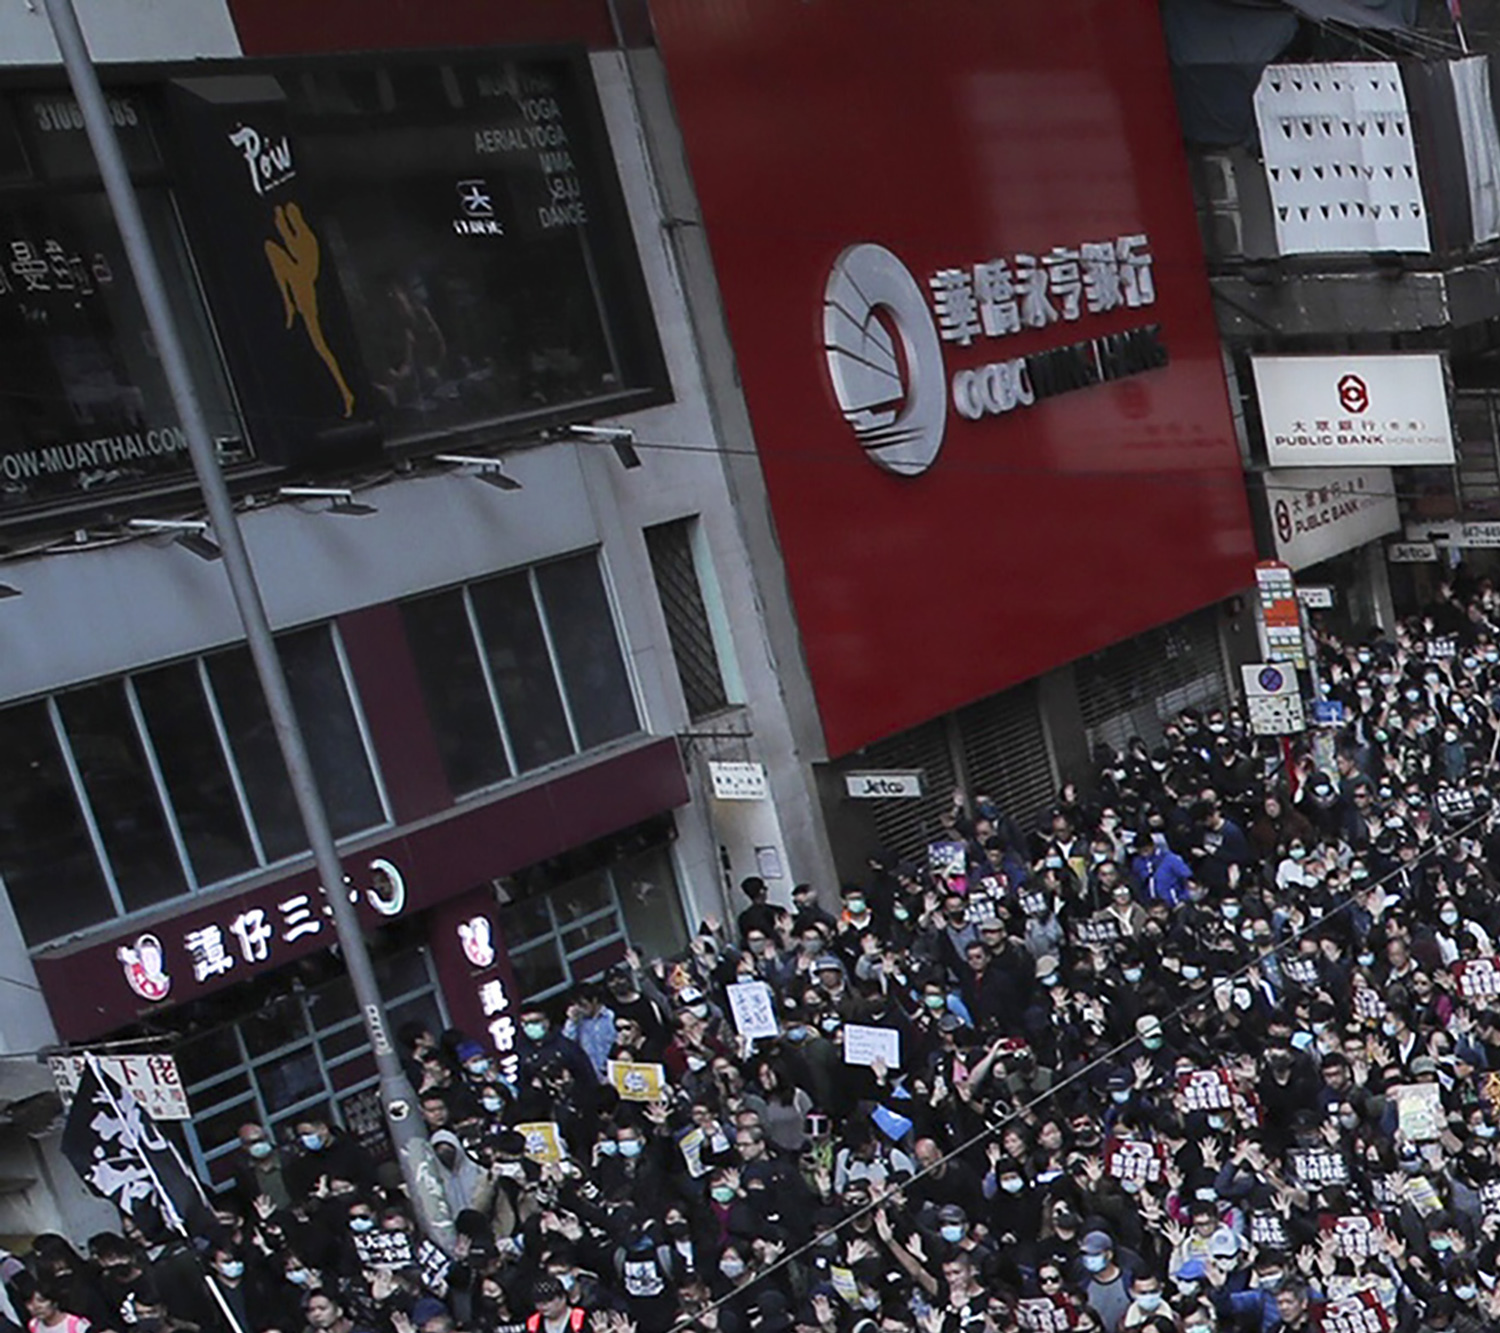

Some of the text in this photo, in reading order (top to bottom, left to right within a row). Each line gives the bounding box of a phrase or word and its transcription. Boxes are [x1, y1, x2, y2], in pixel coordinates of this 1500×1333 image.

[520, 96, 561, 122] YOGA
[475, 124, 568, 154] AERIAL YOGA
[539, 202, 588, 229] DANCE
[930, 233, 1158, 347] 華僑永亨銀行
[953, 358, 1035, 421] OCBC
[1275, 434, 1384, 447] PUBLIC BANK
[1295, 499, 1359, 534] PUBLIC BANK
[184, 876, 358, 982] 譚仔三
